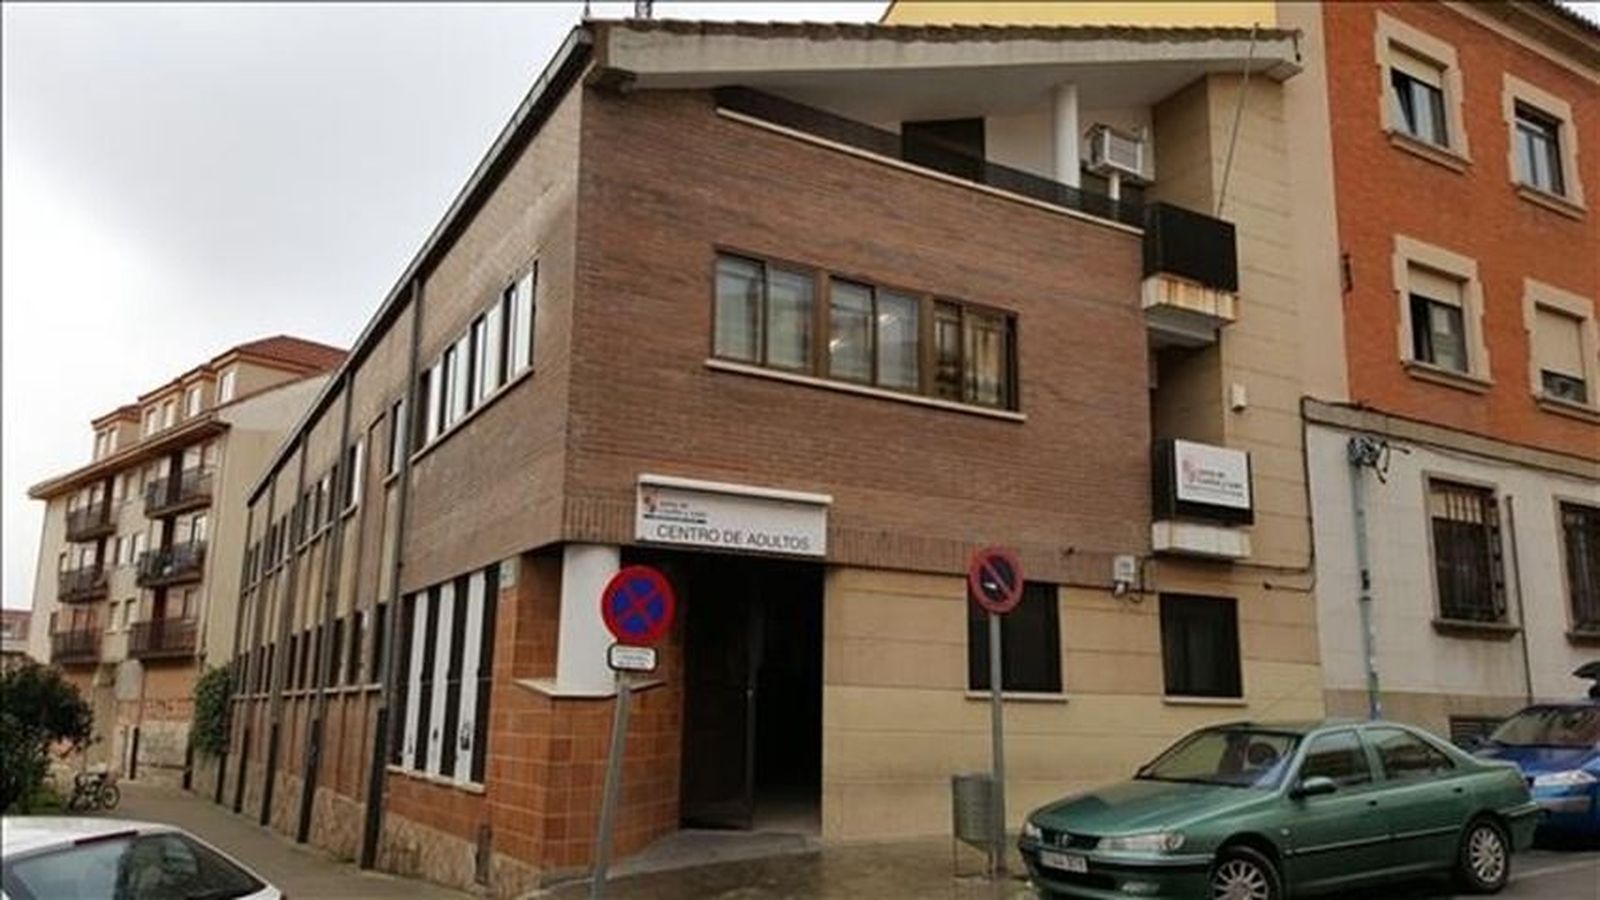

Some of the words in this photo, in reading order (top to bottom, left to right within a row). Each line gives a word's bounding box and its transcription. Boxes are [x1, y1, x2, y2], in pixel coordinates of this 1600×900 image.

[657, 524, 720, 543] CENTRO
[723, 530, 742, 544] DE
[747, 532, 810, 551] ADULTOS
